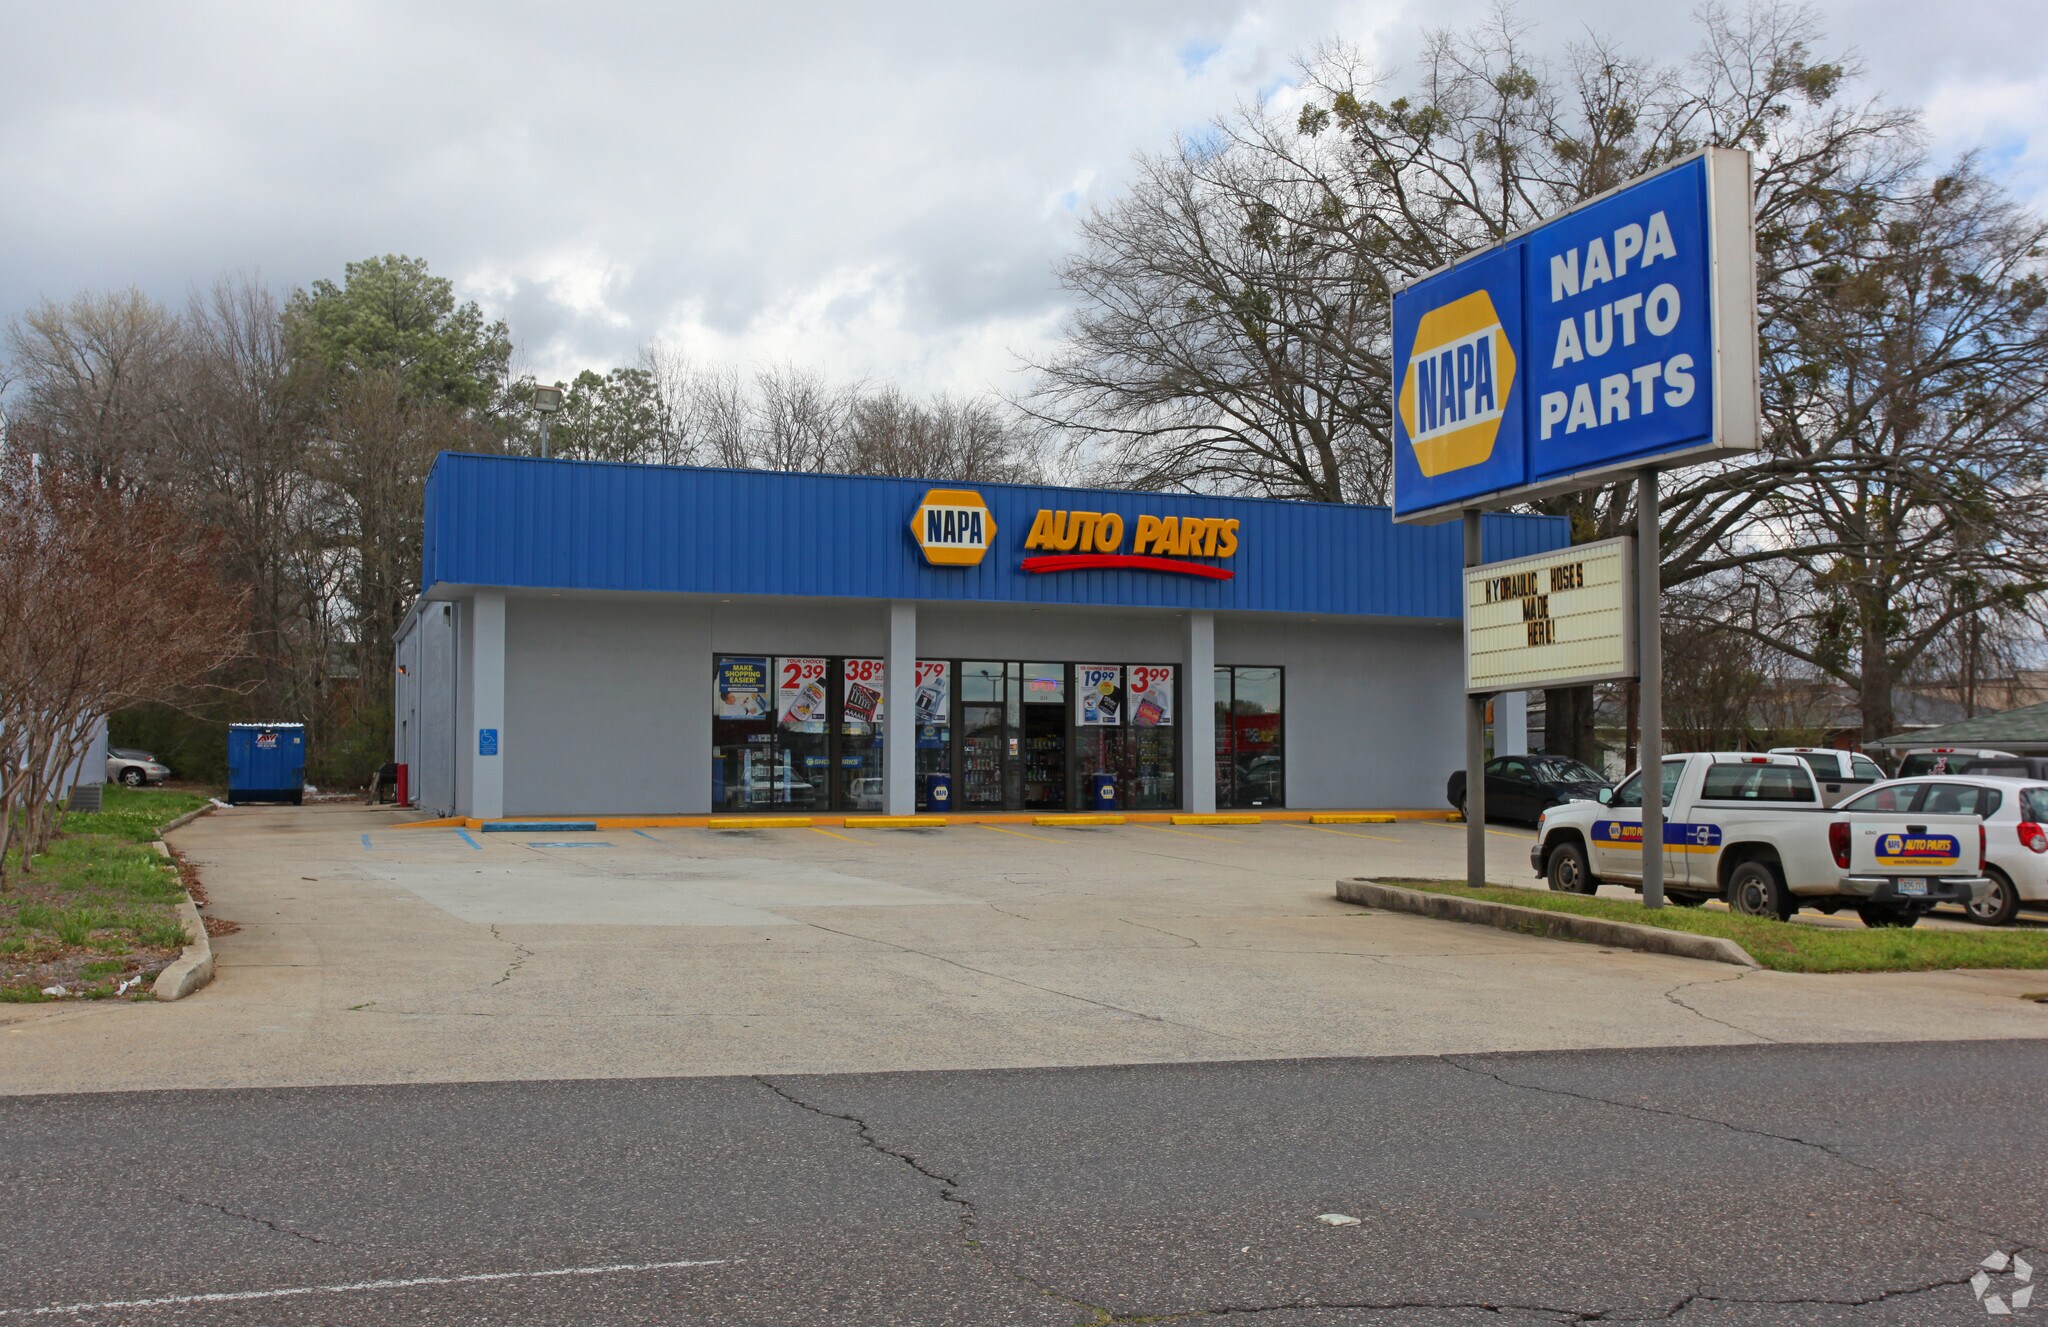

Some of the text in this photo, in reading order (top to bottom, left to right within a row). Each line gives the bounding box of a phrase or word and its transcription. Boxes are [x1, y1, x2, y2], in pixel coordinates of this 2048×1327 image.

[1550, 210, 1677, 303] NAPA
[1552, 283, 1681, 369] AUTO
[1418, 335, 1495, 434] NAPA
[1540, 353, 1695, 440] PARTS
[927, 510, 983, 544] NAPA
[1024, 509, 1240, 558] AUTO PARTS
[1486, 563, 1583, 603] HYDRAULIC HOSES
[1522, 595, 1549, 621] MADE
[1527, 619, 1556, 647] HERE!
[1029, 681, 1056, 692] OPEN
[1621, 826, 1637, 836] AUTO
[1887, 840, 1900, 849] NAPA
[1904, 839, 1952, 851] AUTO PARTS
